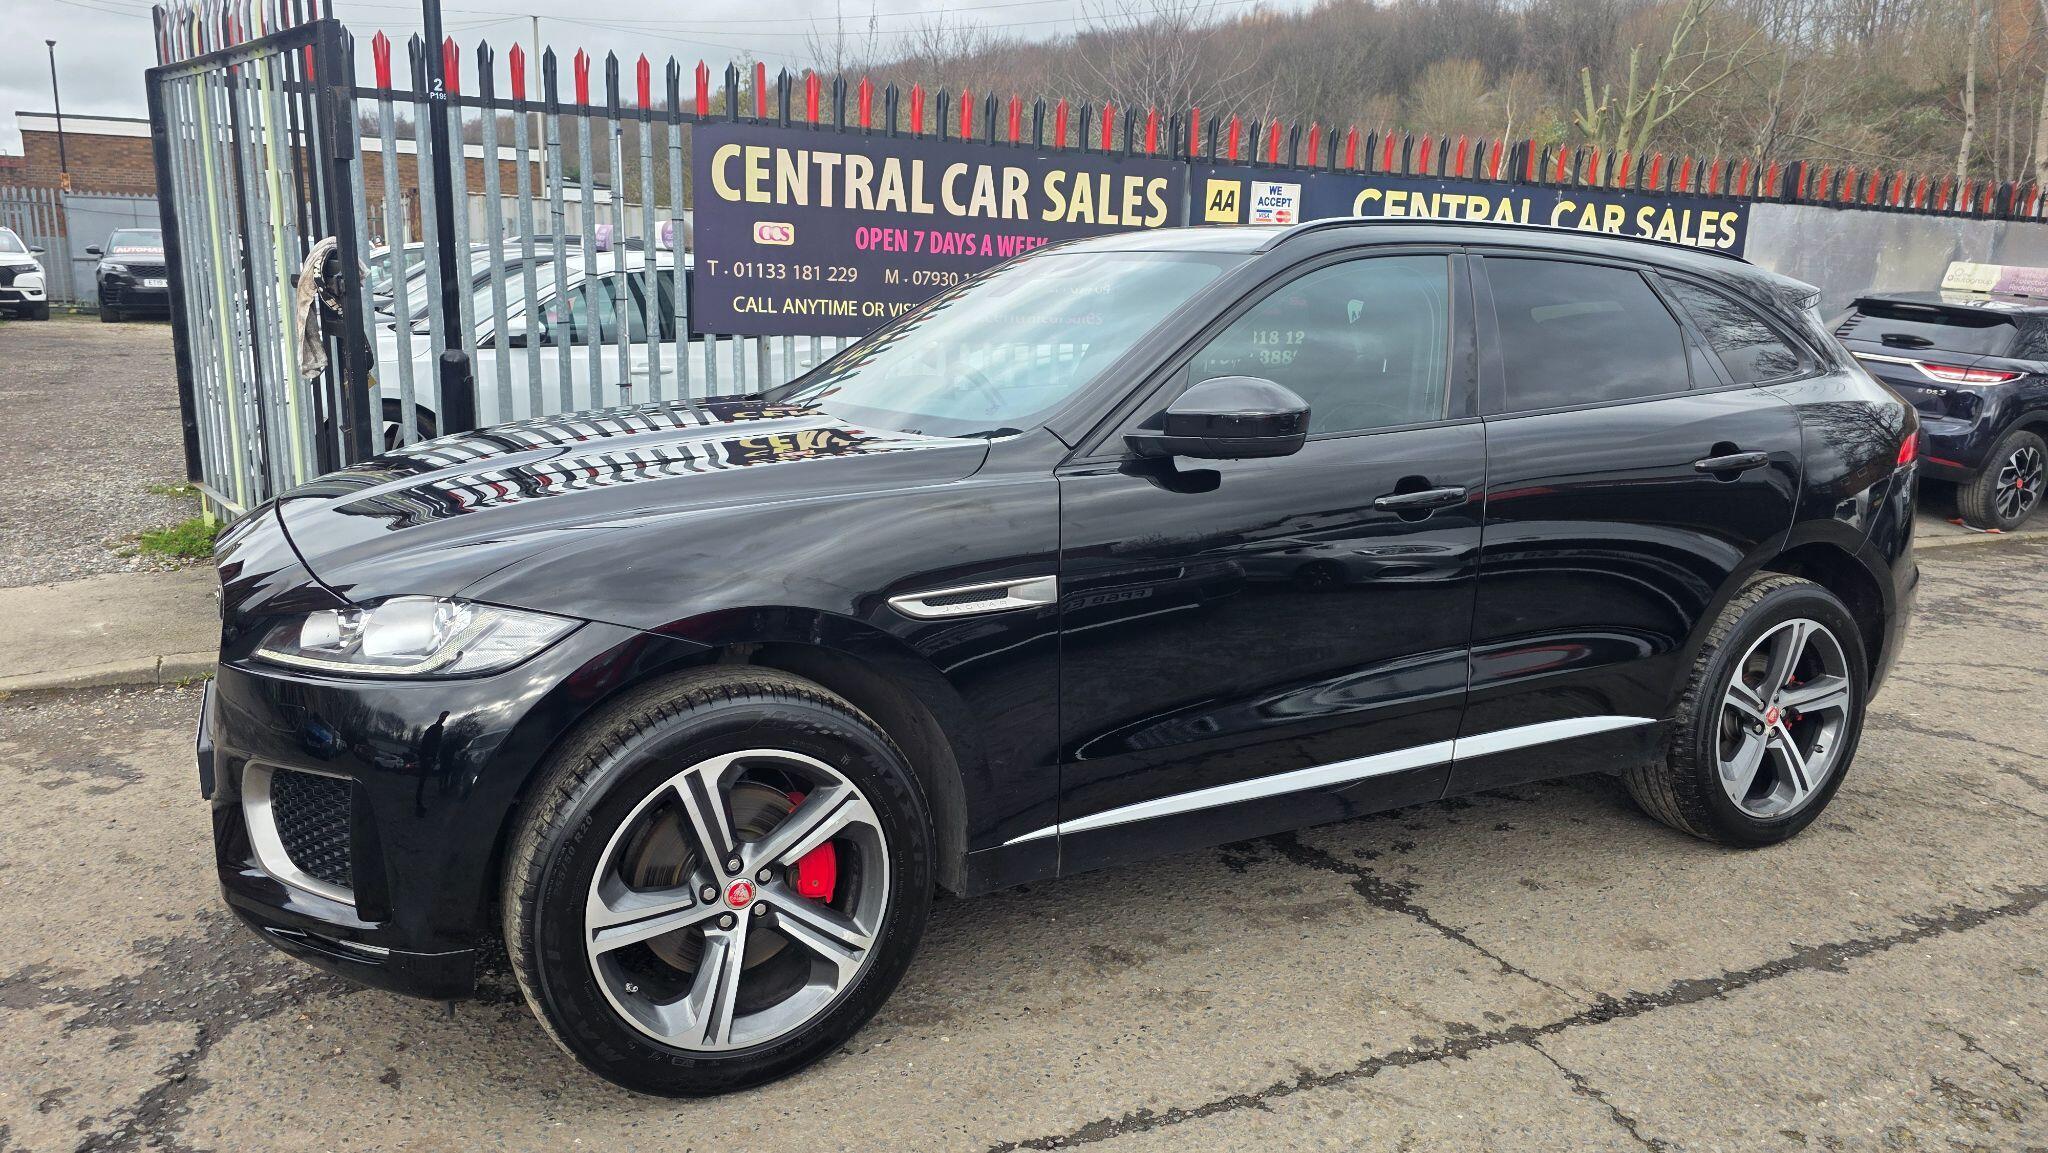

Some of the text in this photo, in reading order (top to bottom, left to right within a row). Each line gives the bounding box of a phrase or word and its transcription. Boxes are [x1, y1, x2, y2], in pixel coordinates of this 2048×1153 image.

[434, 78, 443, 91] 2
[711, 143, 1168, 228] CENTRAL CAR SALES
[1269, 185, 1283, 195] WE
[1209, 189, 1235, 211] AA
[1257, 196, 1292, 208] ACCEPT
[1550, 200, 1626, 236] CAR
[1635, 206, 1739, 249] SALES
[855, 226, 908, 252] OPEN
[913, 230, 925, 253] 7
[930, 231, 976, 256] DAYS
[980, 234, 993, 257] A
[733, 261, 786, 279] 01133
[793, 265, 820, 281] 181
[826, 266, 858, 282] 229
[912, 270, 958, 286] 07930
[733, 296, 777, 314] CALL
[783, 297, 858, 316] ANYTIME
[862, 301, 884, 317] OR
[943, 601, 1008, 613] JAGUAR
